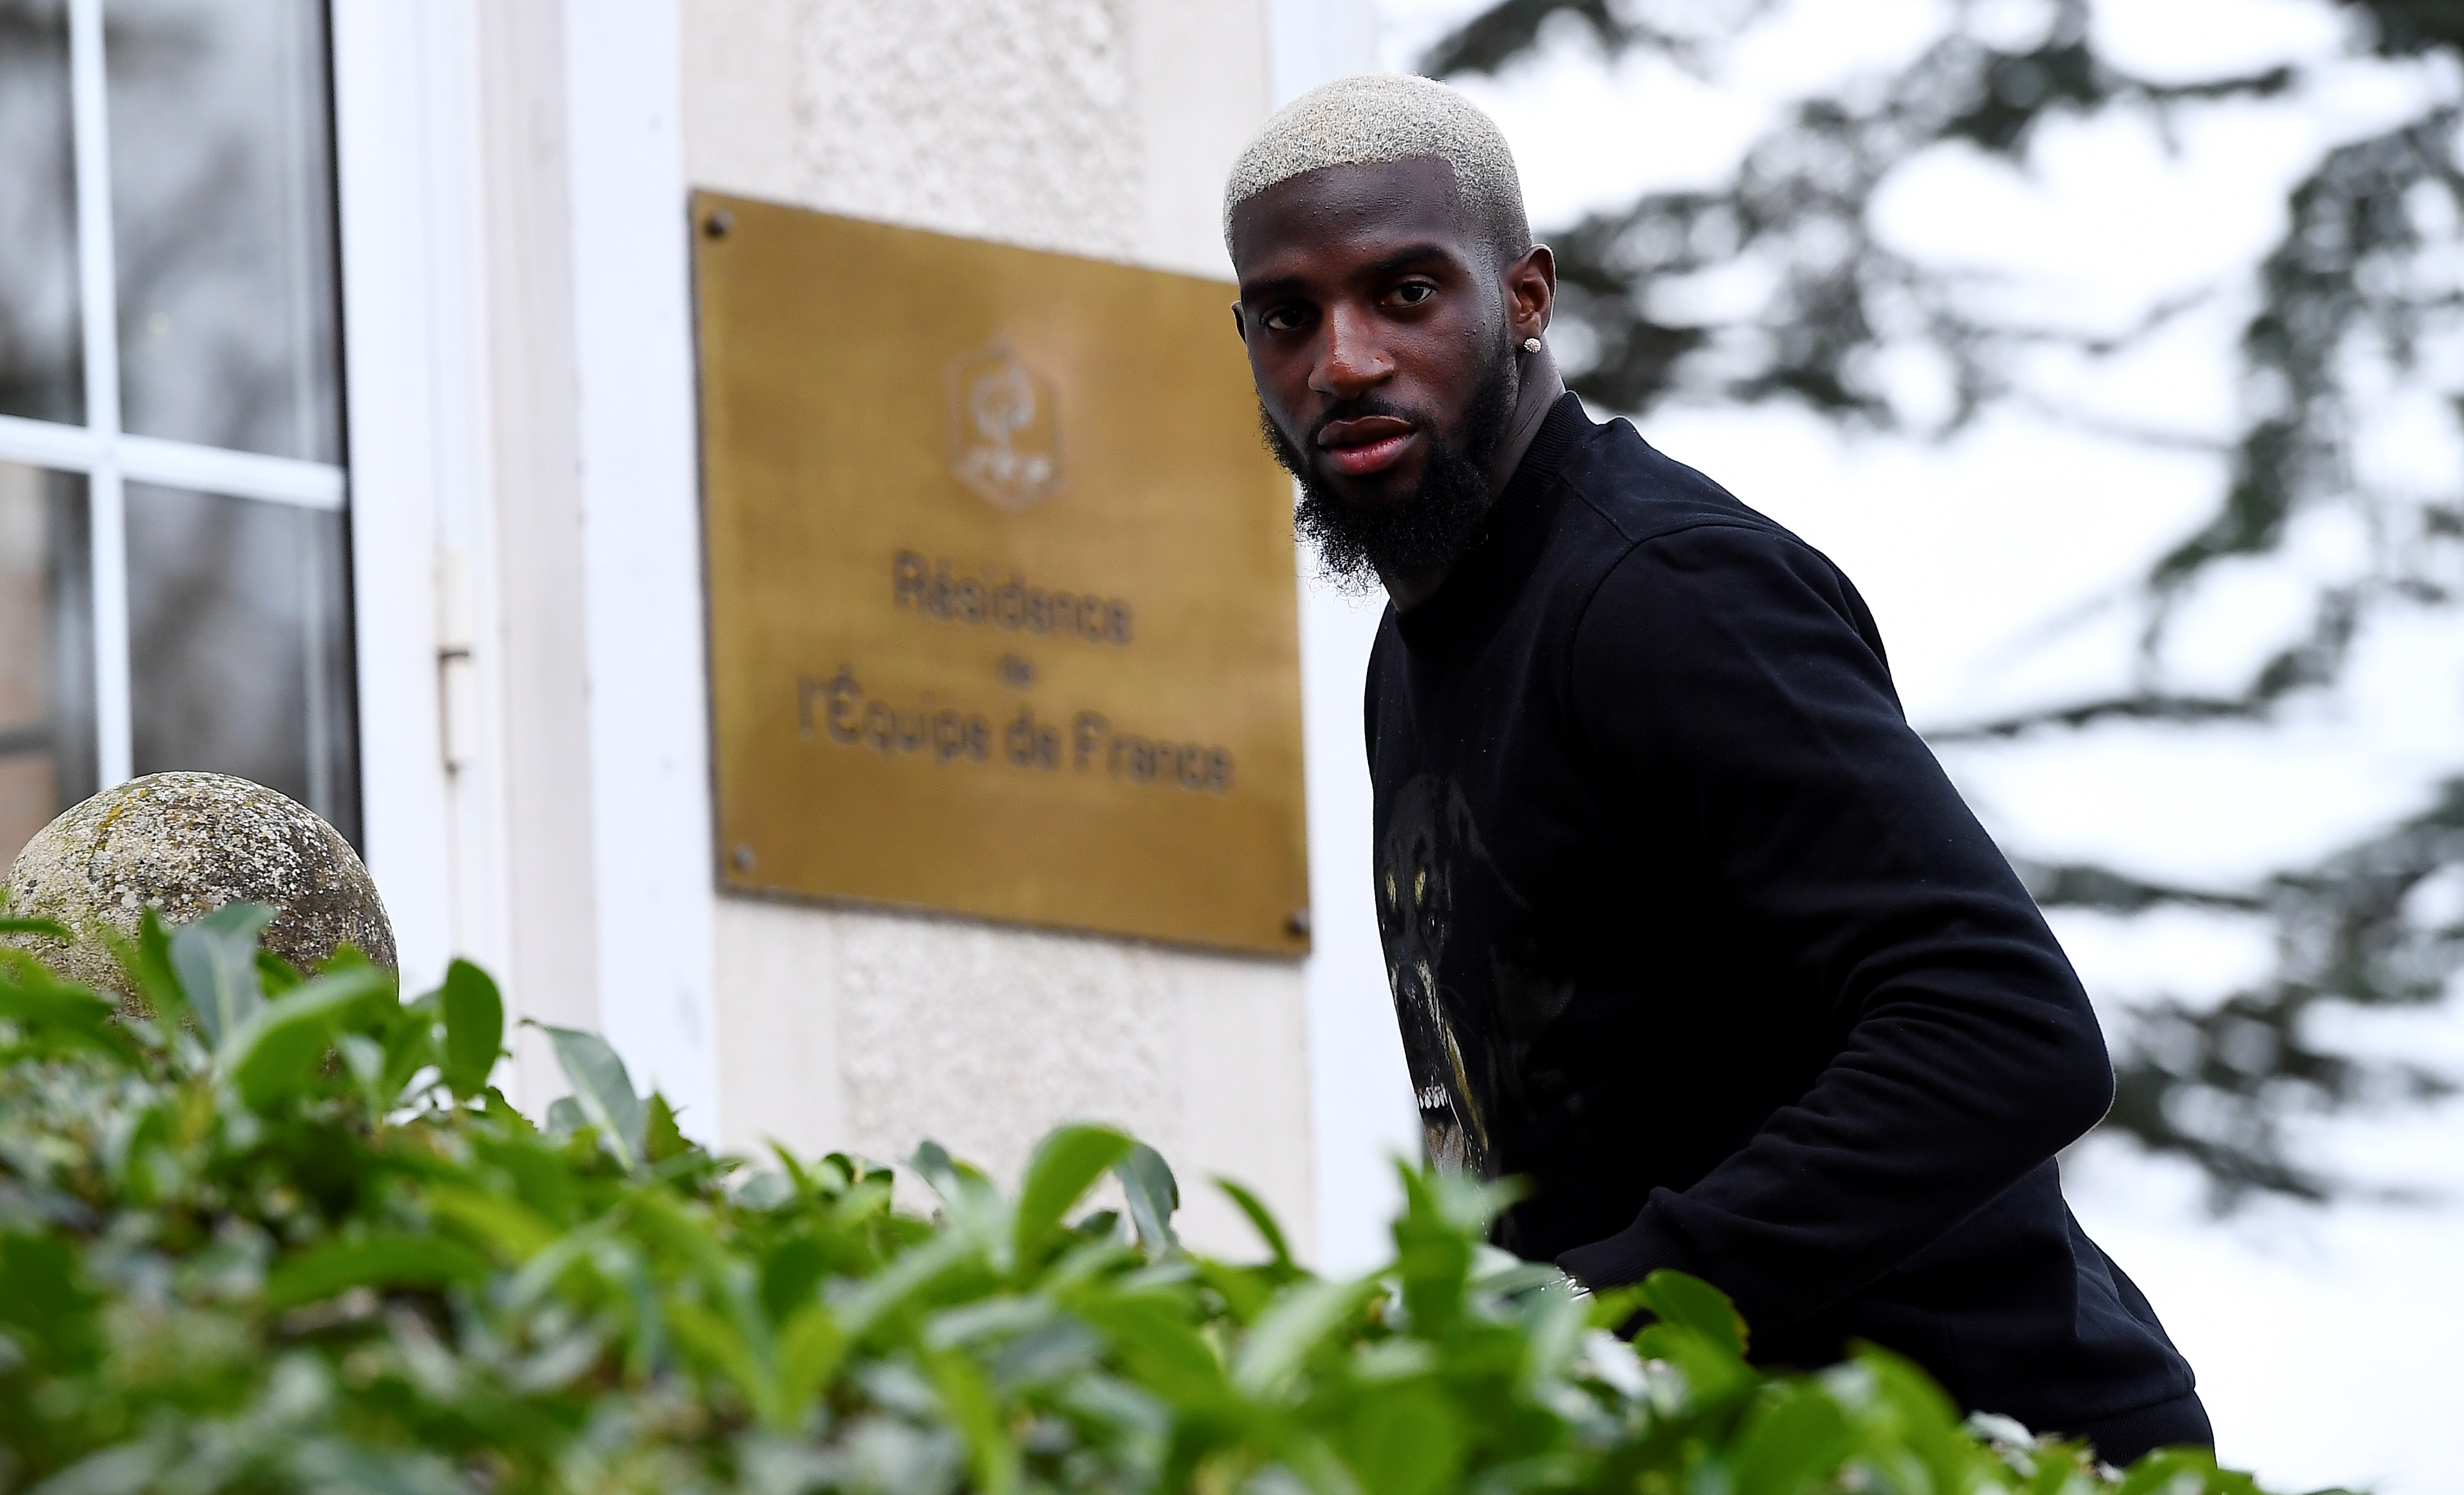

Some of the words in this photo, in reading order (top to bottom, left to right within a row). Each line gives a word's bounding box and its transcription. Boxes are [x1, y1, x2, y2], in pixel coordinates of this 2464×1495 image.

[894, 552, 1131, 646] Résidence
[1007, 711, 1060, 770] de
[1075, 713, 1232, 792] France
